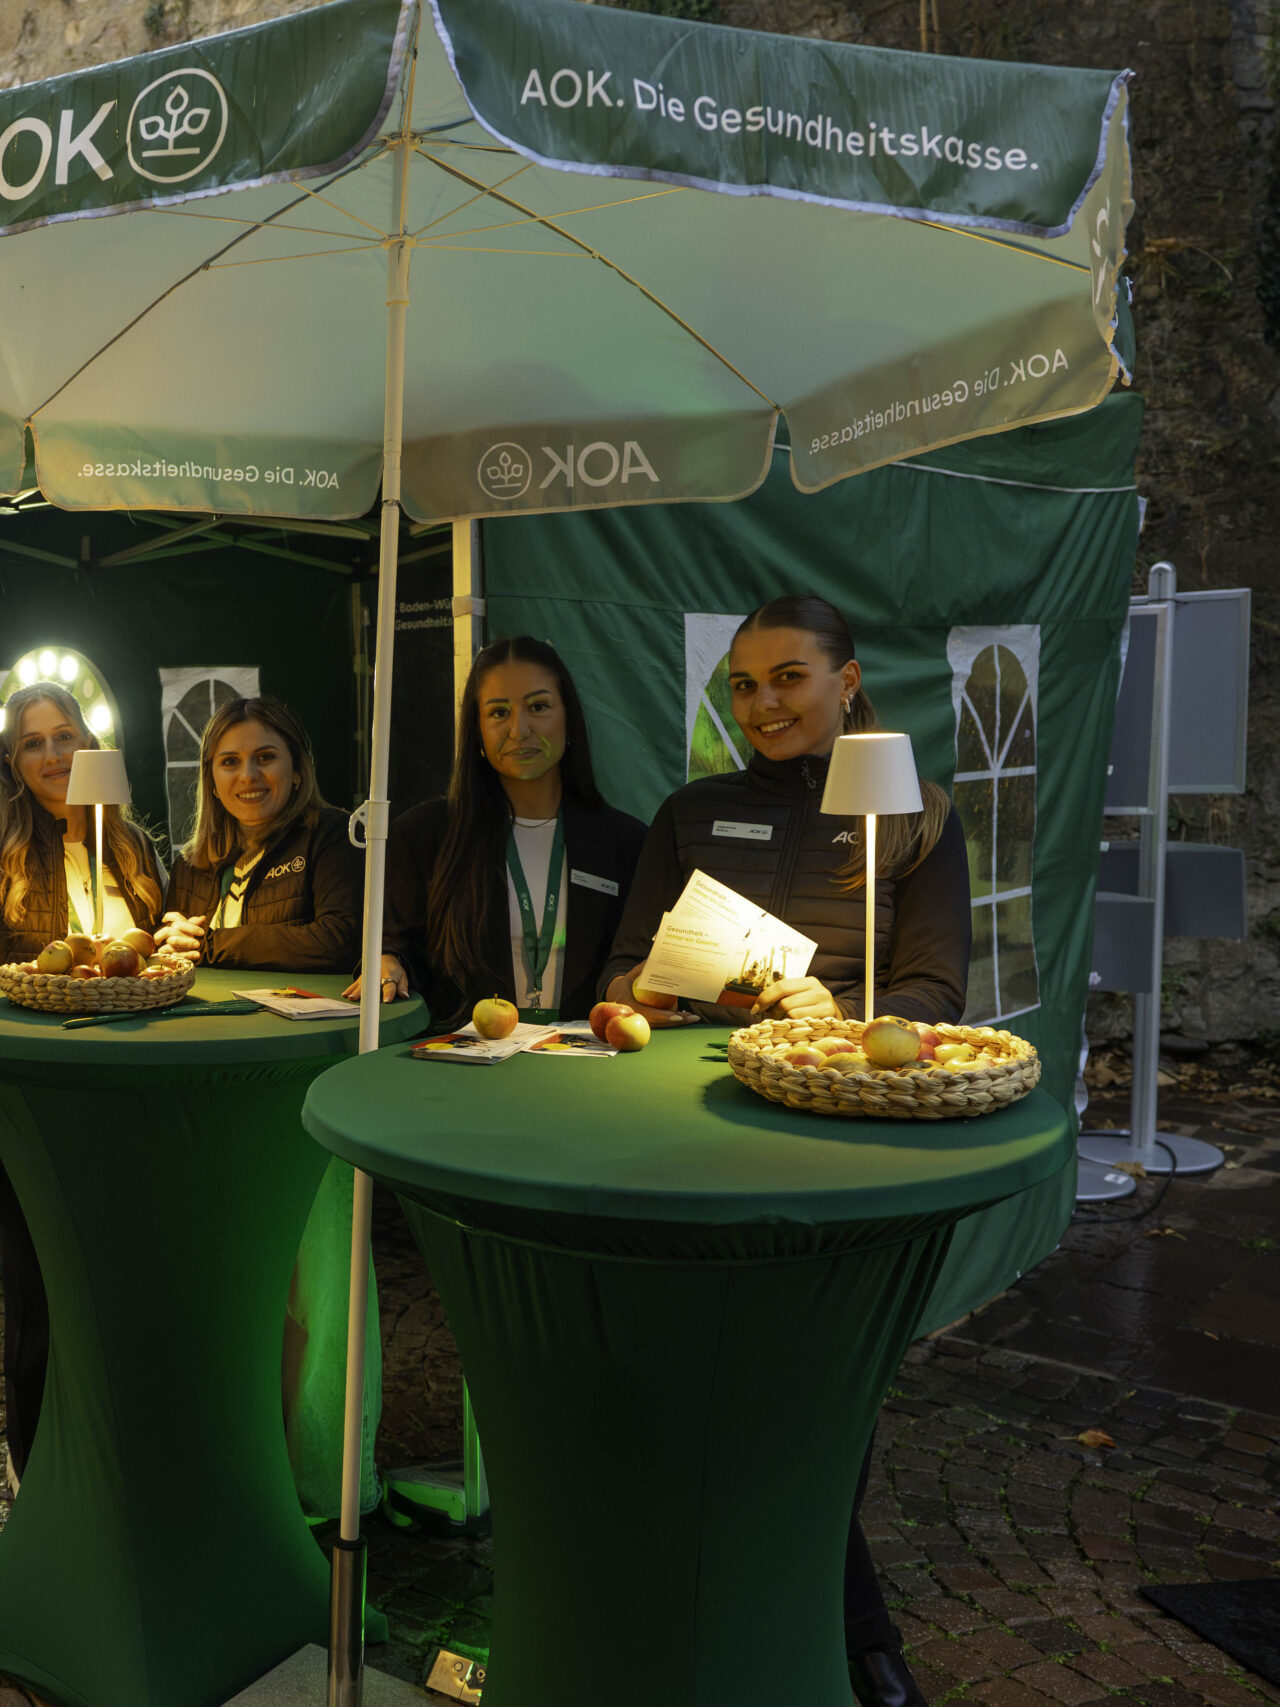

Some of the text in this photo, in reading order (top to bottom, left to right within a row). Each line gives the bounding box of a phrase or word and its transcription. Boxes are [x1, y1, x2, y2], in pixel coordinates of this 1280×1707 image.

[520, 68, 1039, 171] AOK. Die Gesundheitskasse.
[395, 615, 454, 631] Gesundheits
[832, 831, 860, 845] AO
[264, 861, 291, 880] AOK
[666, 925, 703, 937] Gesundheit
